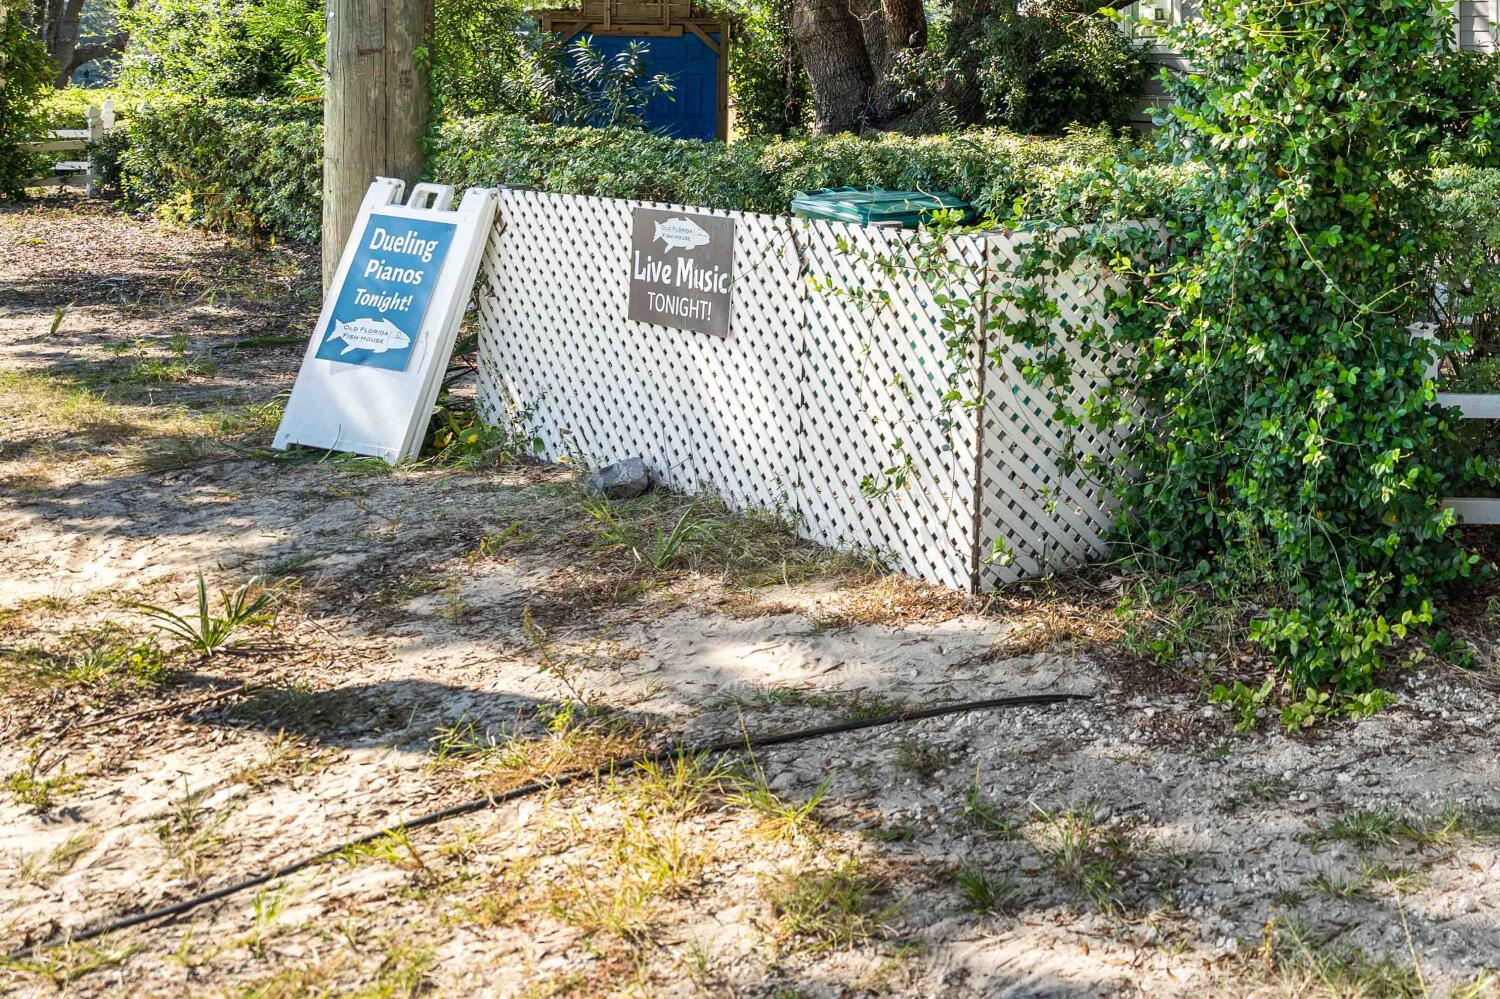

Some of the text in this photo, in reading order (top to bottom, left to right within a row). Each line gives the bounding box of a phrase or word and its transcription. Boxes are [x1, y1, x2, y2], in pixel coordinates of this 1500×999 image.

[369, 227, 439, 263] Dueling
[363, 258, 424, 285] Pianos
[634, 250, 729, 295] Live Music
[354, 287, 413, 313] Tonight!
[647, 291, 712, 322] TONIGHT!
[342, 332, 384, 344] FISH HOUSE
[343, 324, 389, 336] OLD FLORIDA
